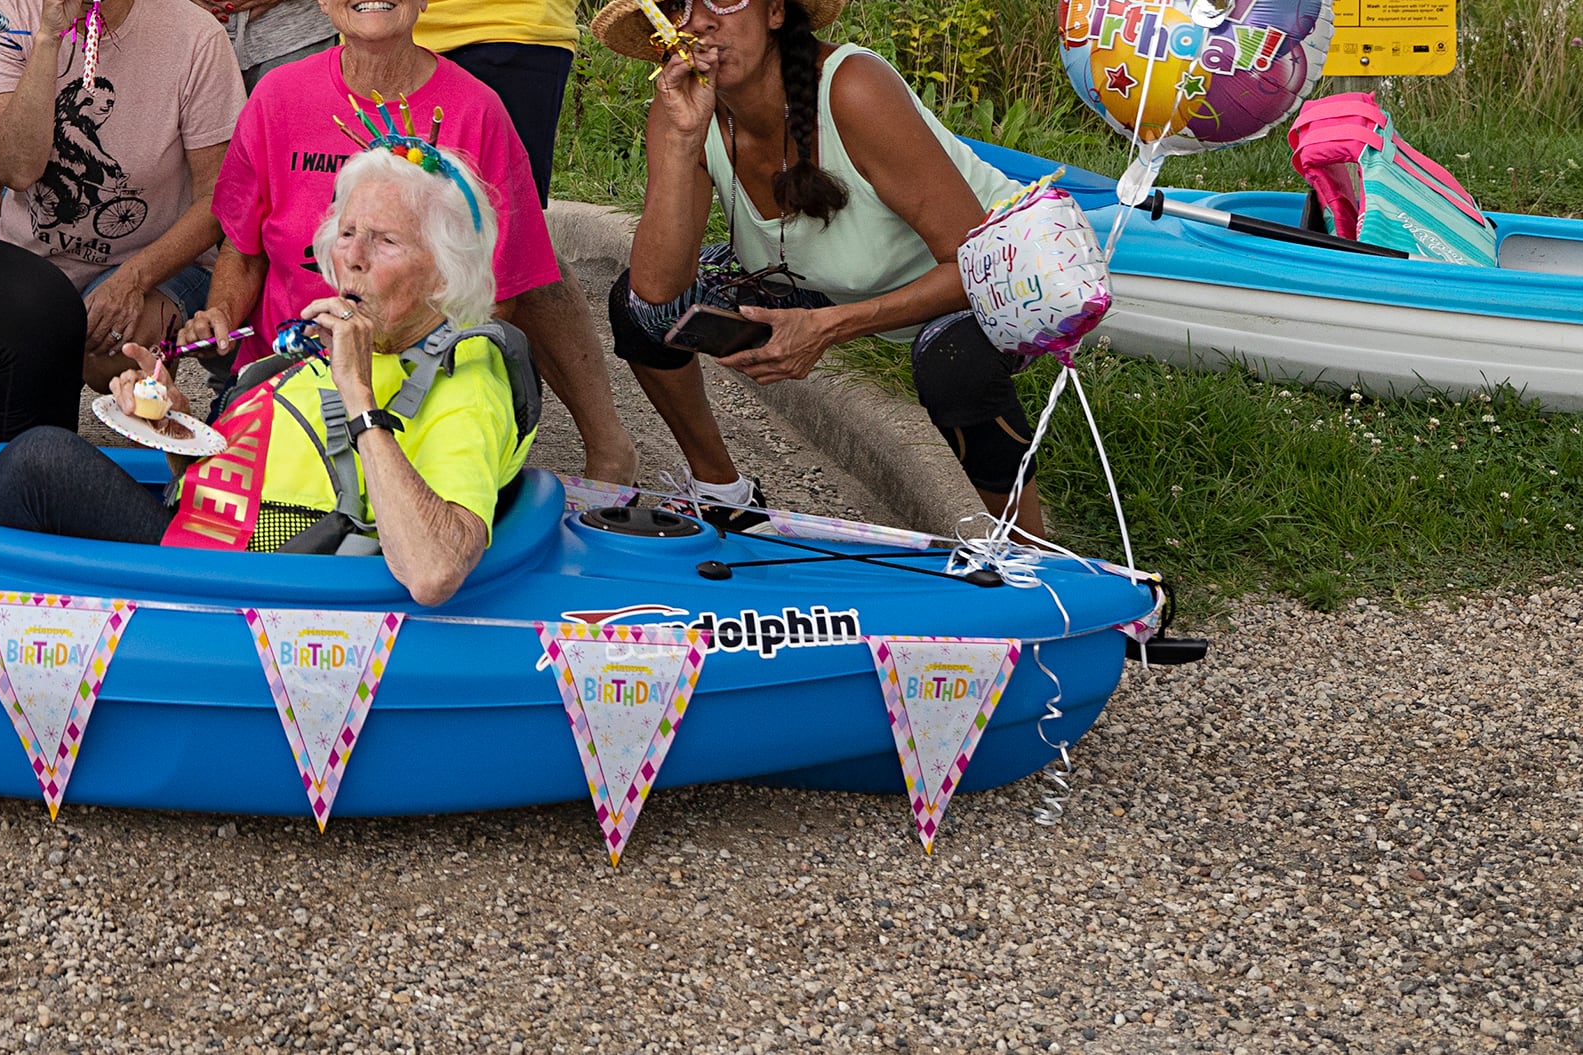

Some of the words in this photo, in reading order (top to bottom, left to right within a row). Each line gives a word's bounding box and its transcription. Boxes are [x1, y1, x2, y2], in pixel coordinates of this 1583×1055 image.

[291, 152, 298, 171] I
[302, 152, 350, 173] WANT
[963, 244, 1016, 289] Happy
[968, 274, 1043, 329] Birthday
